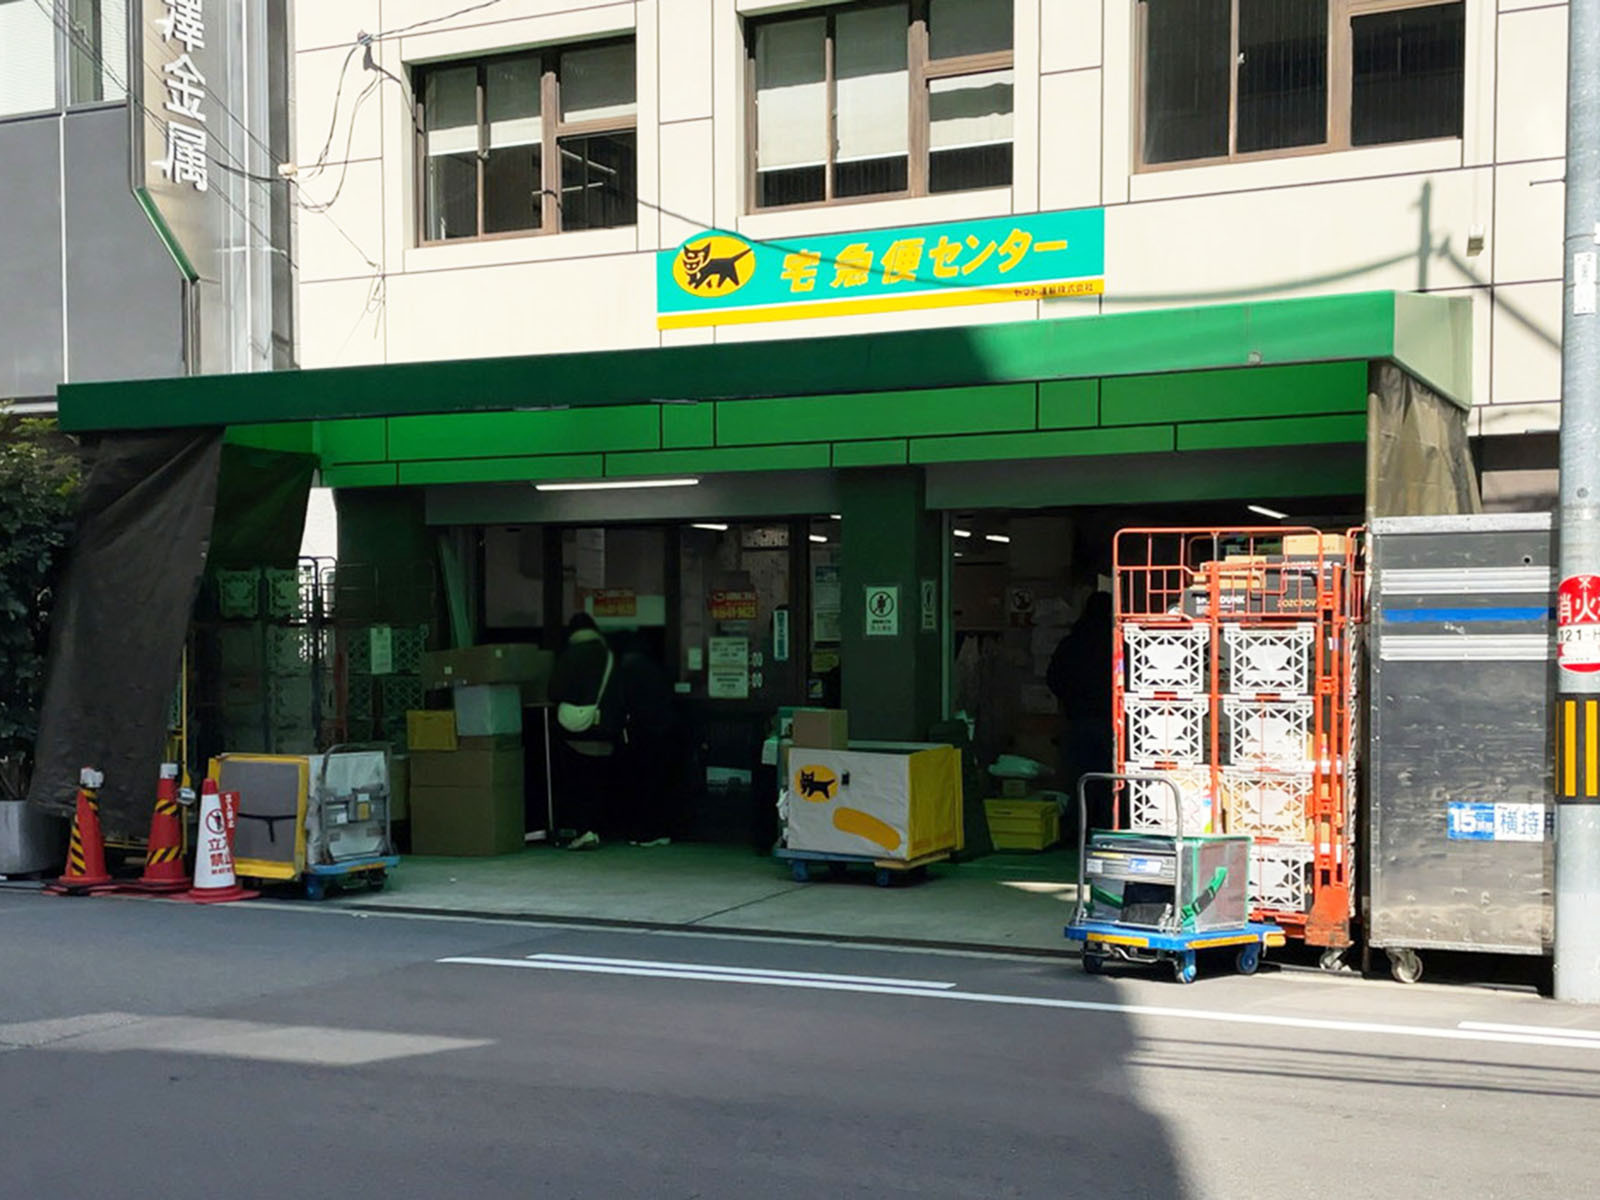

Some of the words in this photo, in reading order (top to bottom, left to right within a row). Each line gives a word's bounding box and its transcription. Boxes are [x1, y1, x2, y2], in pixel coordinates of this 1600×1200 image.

[779, 227, 1068, 293] 宅急便センター
